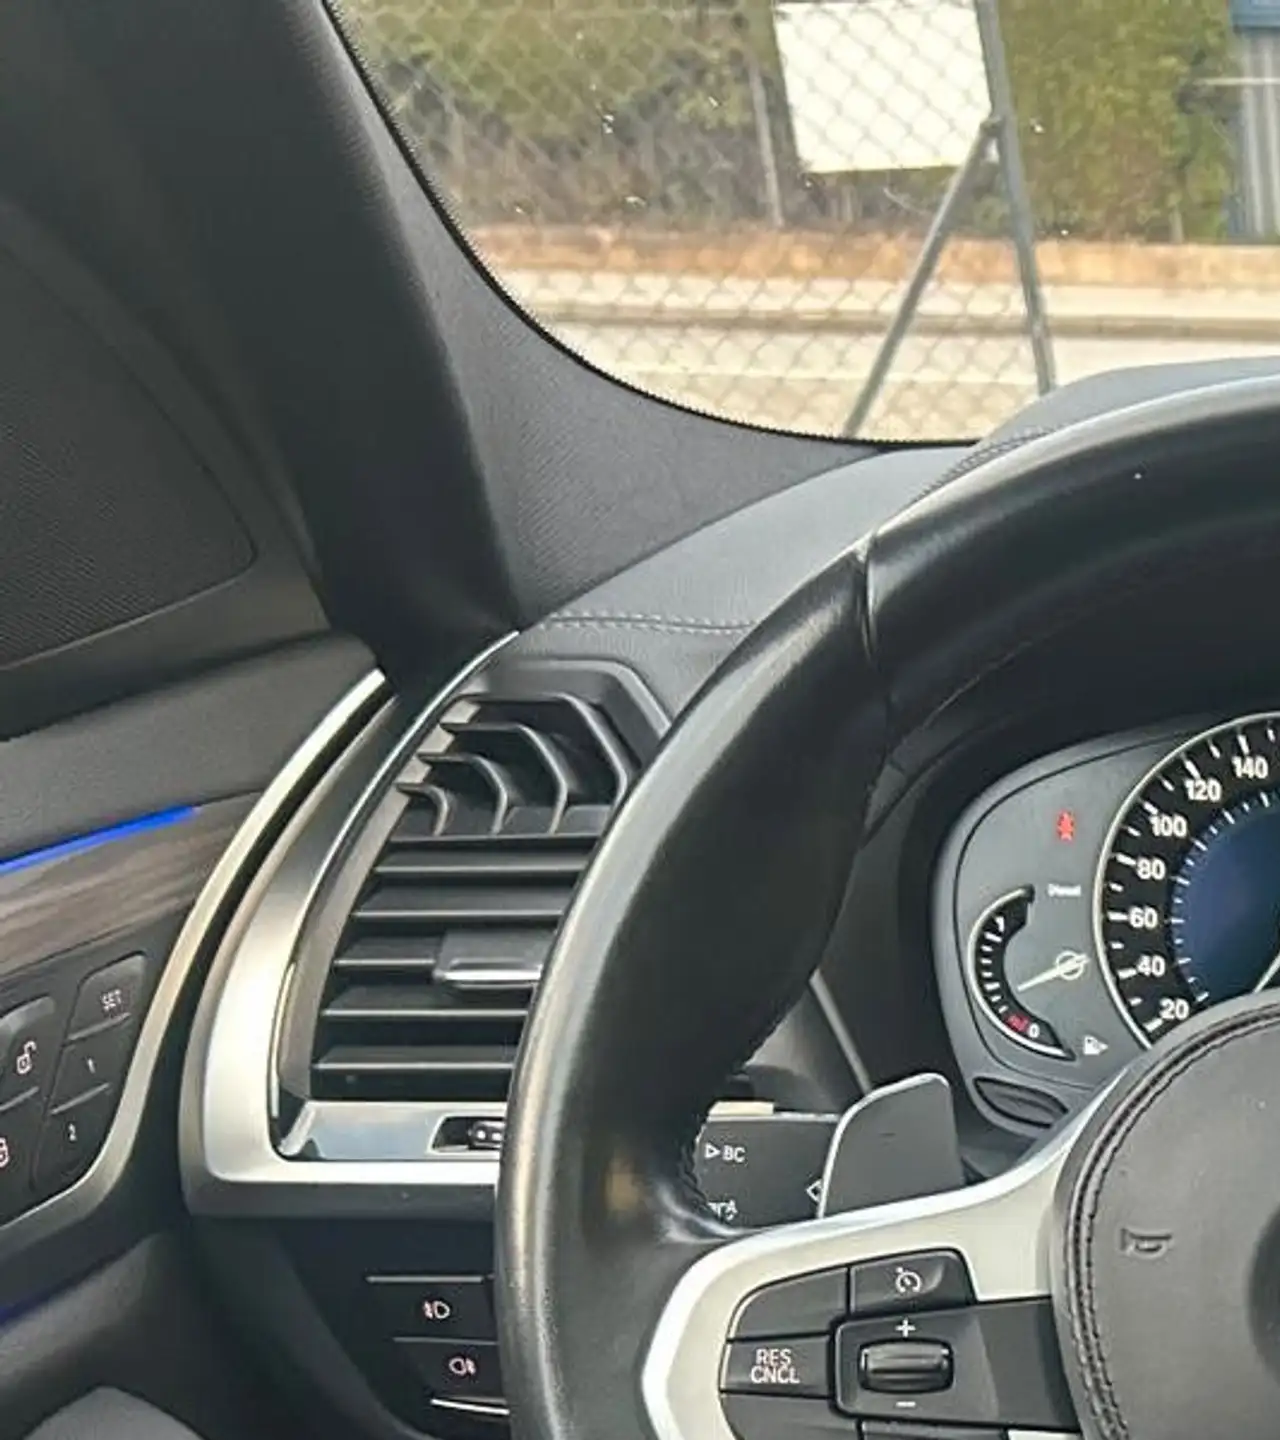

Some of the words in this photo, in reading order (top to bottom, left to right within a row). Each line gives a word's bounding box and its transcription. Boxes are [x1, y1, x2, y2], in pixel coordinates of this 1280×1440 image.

[1232, 756, 1269, 780] 140
[1184, 777, 1223, 802] 120
[1149, 815, 1188, 839] 100
[1136, 858, 1166, 881] 80
[1128, 906, 1158, 929] 60
[1136, 955, 1166, 977] 40
[1159, 999, 1190, 1021] 20
[722, 1144, 746, 1163] BC
[755, 1347, 792, 1368] RES
[749, 1365, 801, 1385] CNCL
